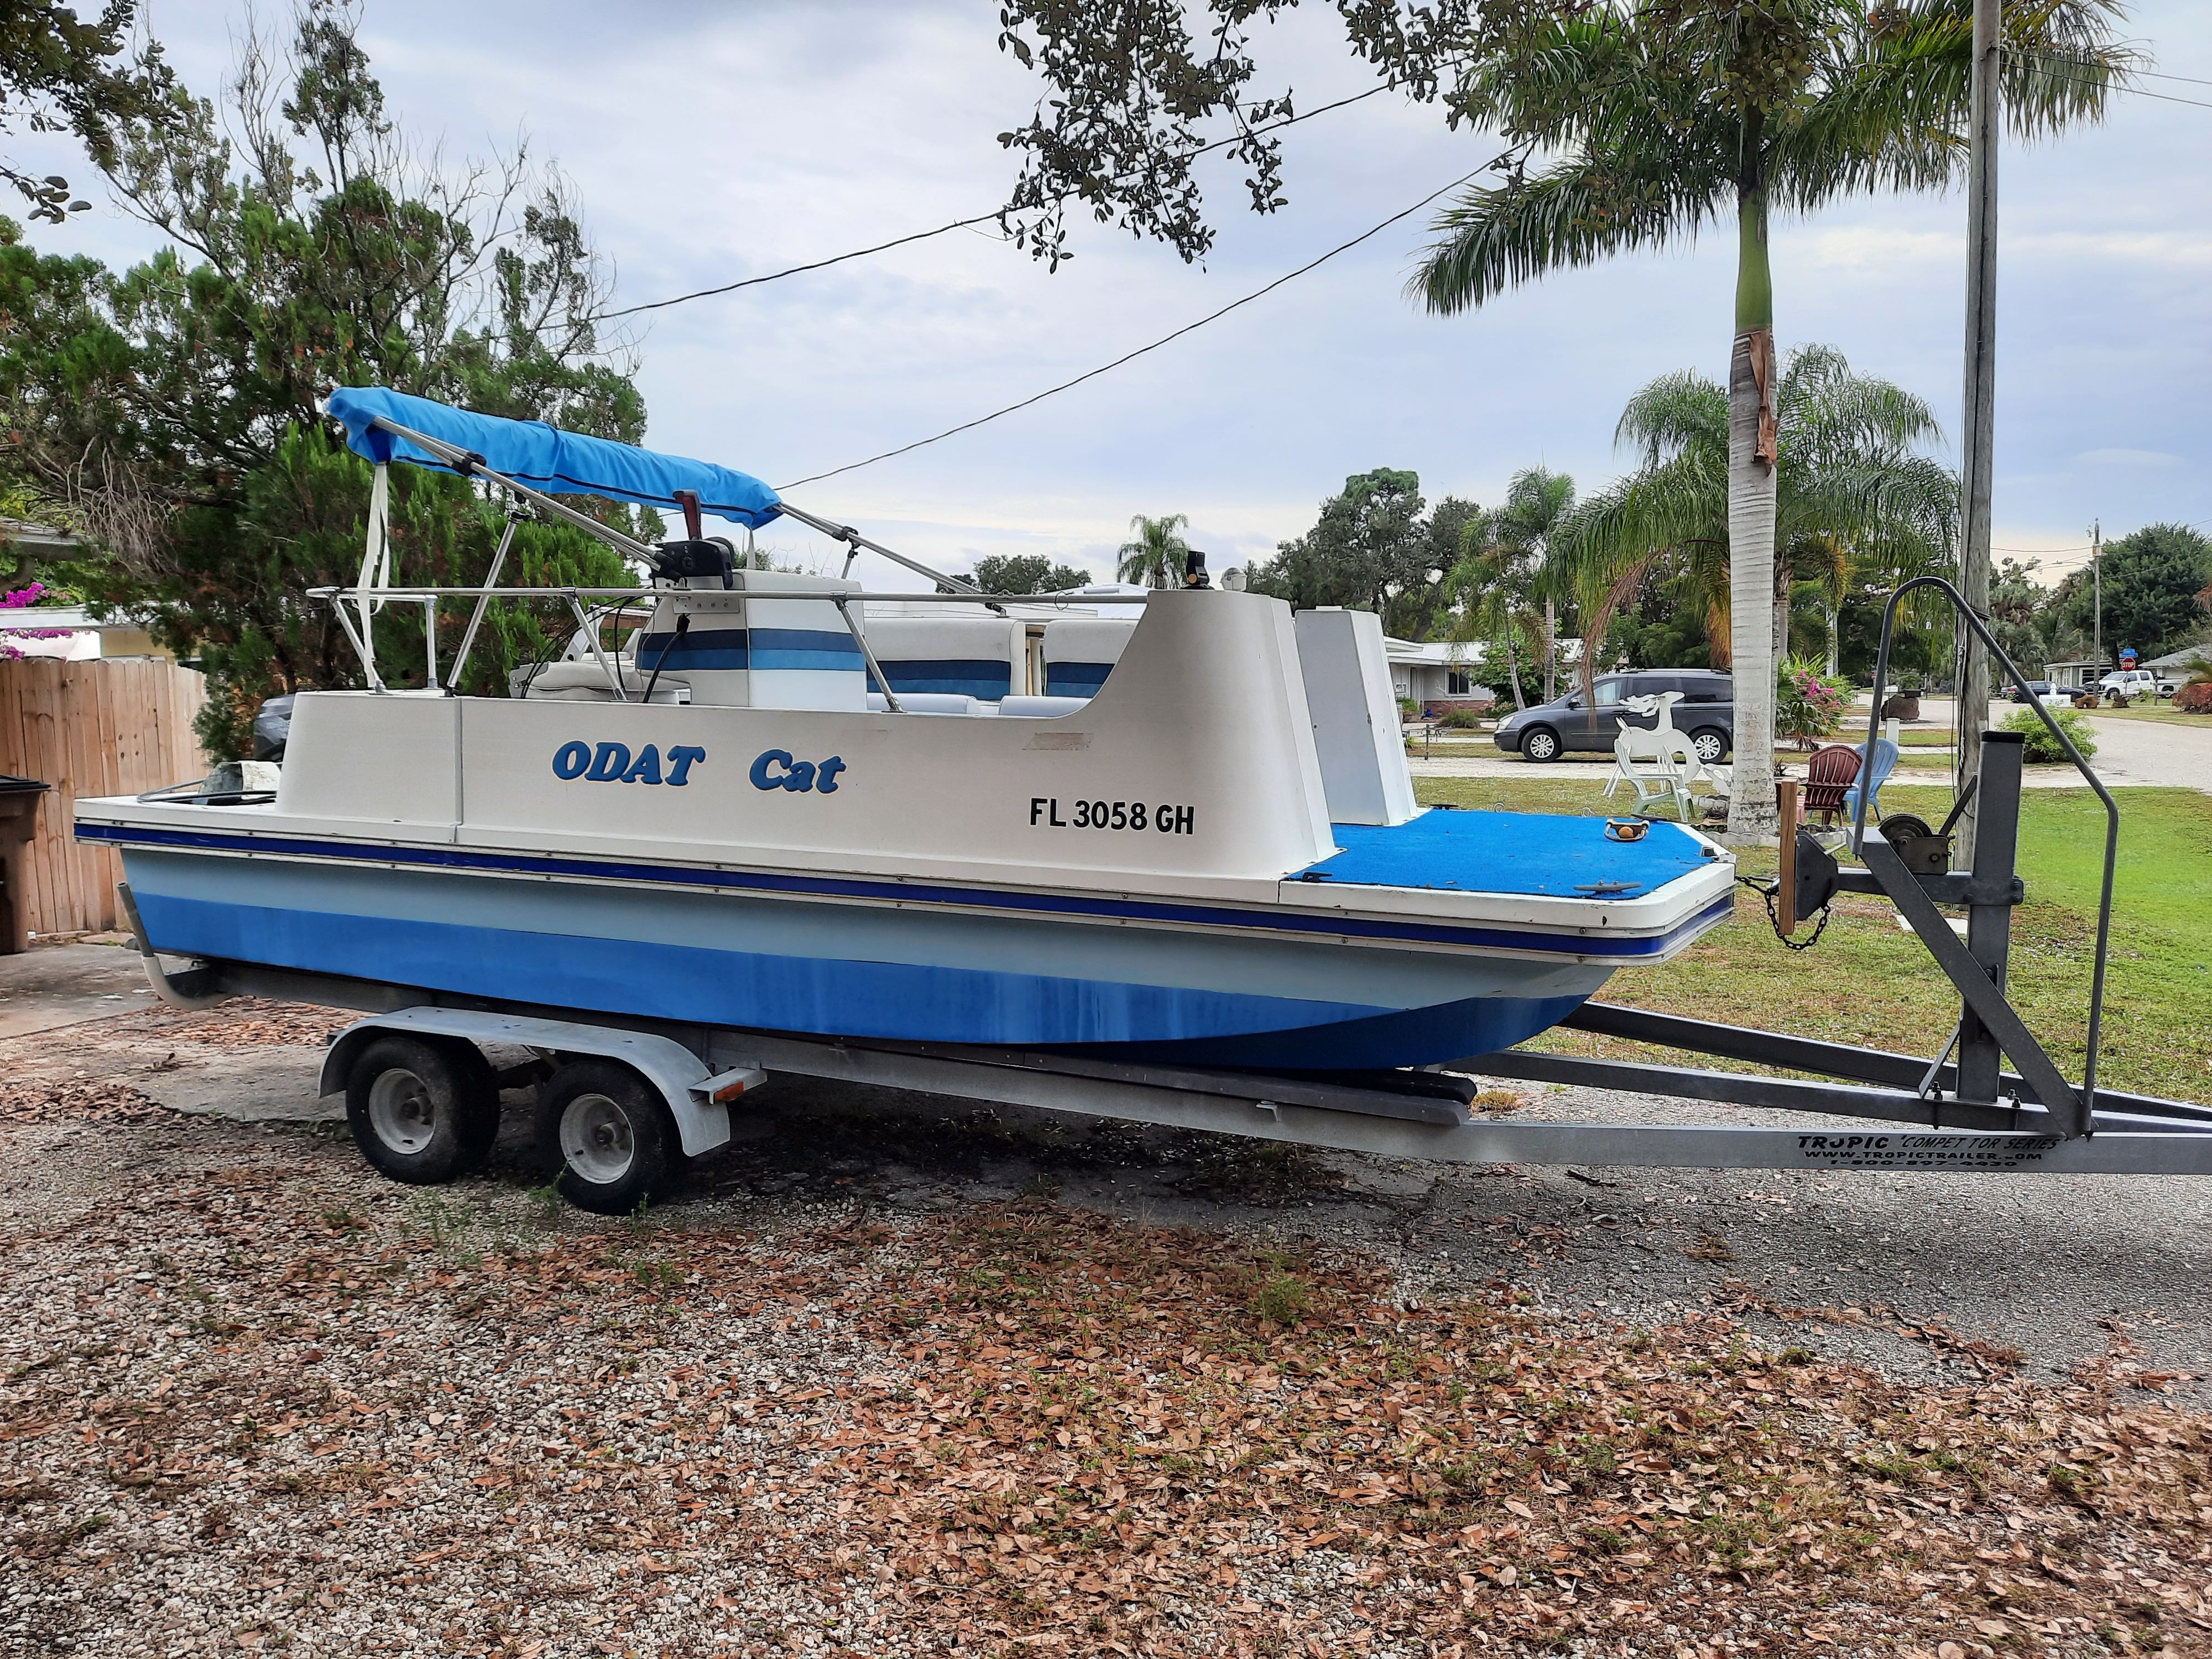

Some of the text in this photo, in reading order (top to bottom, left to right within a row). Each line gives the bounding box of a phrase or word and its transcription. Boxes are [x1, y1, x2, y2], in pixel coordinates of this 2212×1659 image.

[552, 740, 847, 795] ODAT Cat
[1030, 797, 1194, 835] FL 3058 GH
[1798, 1136, 1889, 1149] TROPIC
